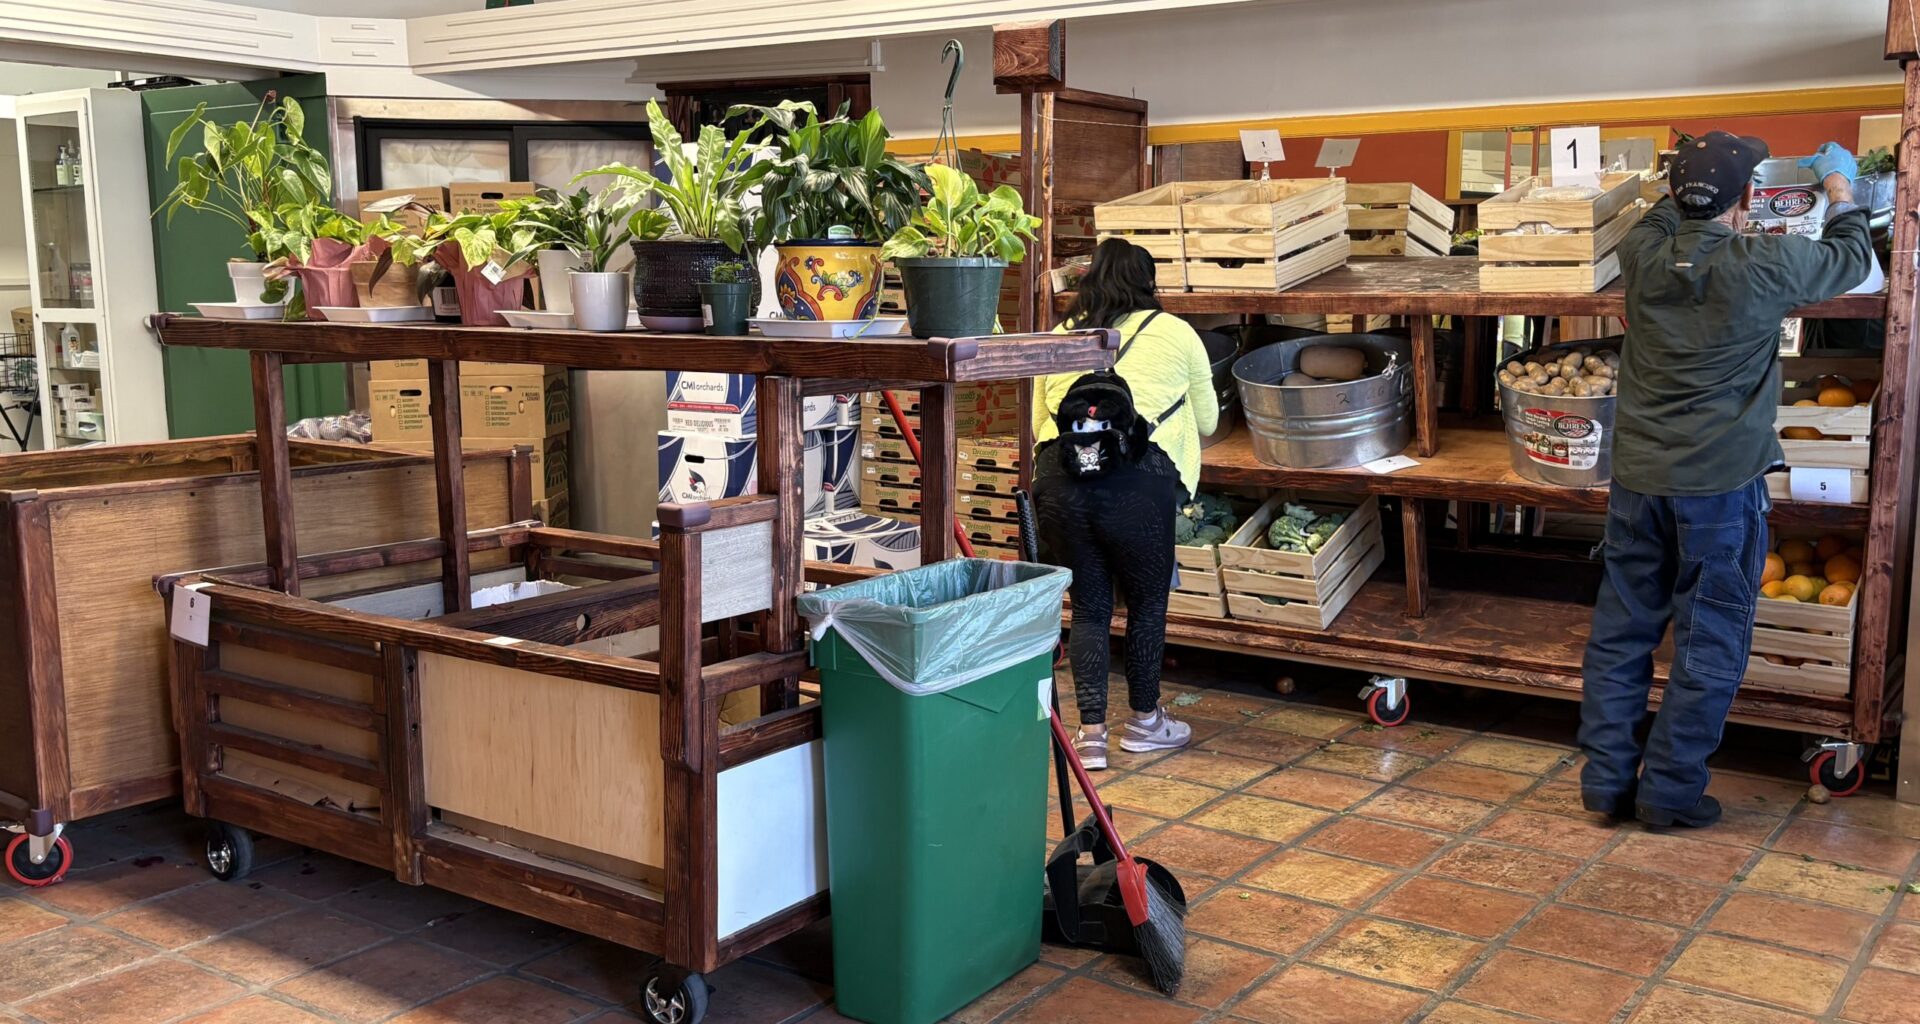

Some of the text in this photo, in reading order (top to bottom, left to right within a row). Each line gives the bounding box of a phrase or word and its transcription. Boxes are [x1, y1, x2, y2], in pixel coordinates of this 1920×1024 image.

[1566, 138, 1577, 169] 1
[1685, 182, 1719, 194] FRANCISCO
[1774, 197, 1813, 208] BEHRENS
[696, 381, 724, 391] orchards
[1557, 421, 1591, 430] BEHRENS
[1820, 481, 1827, 491] 5
